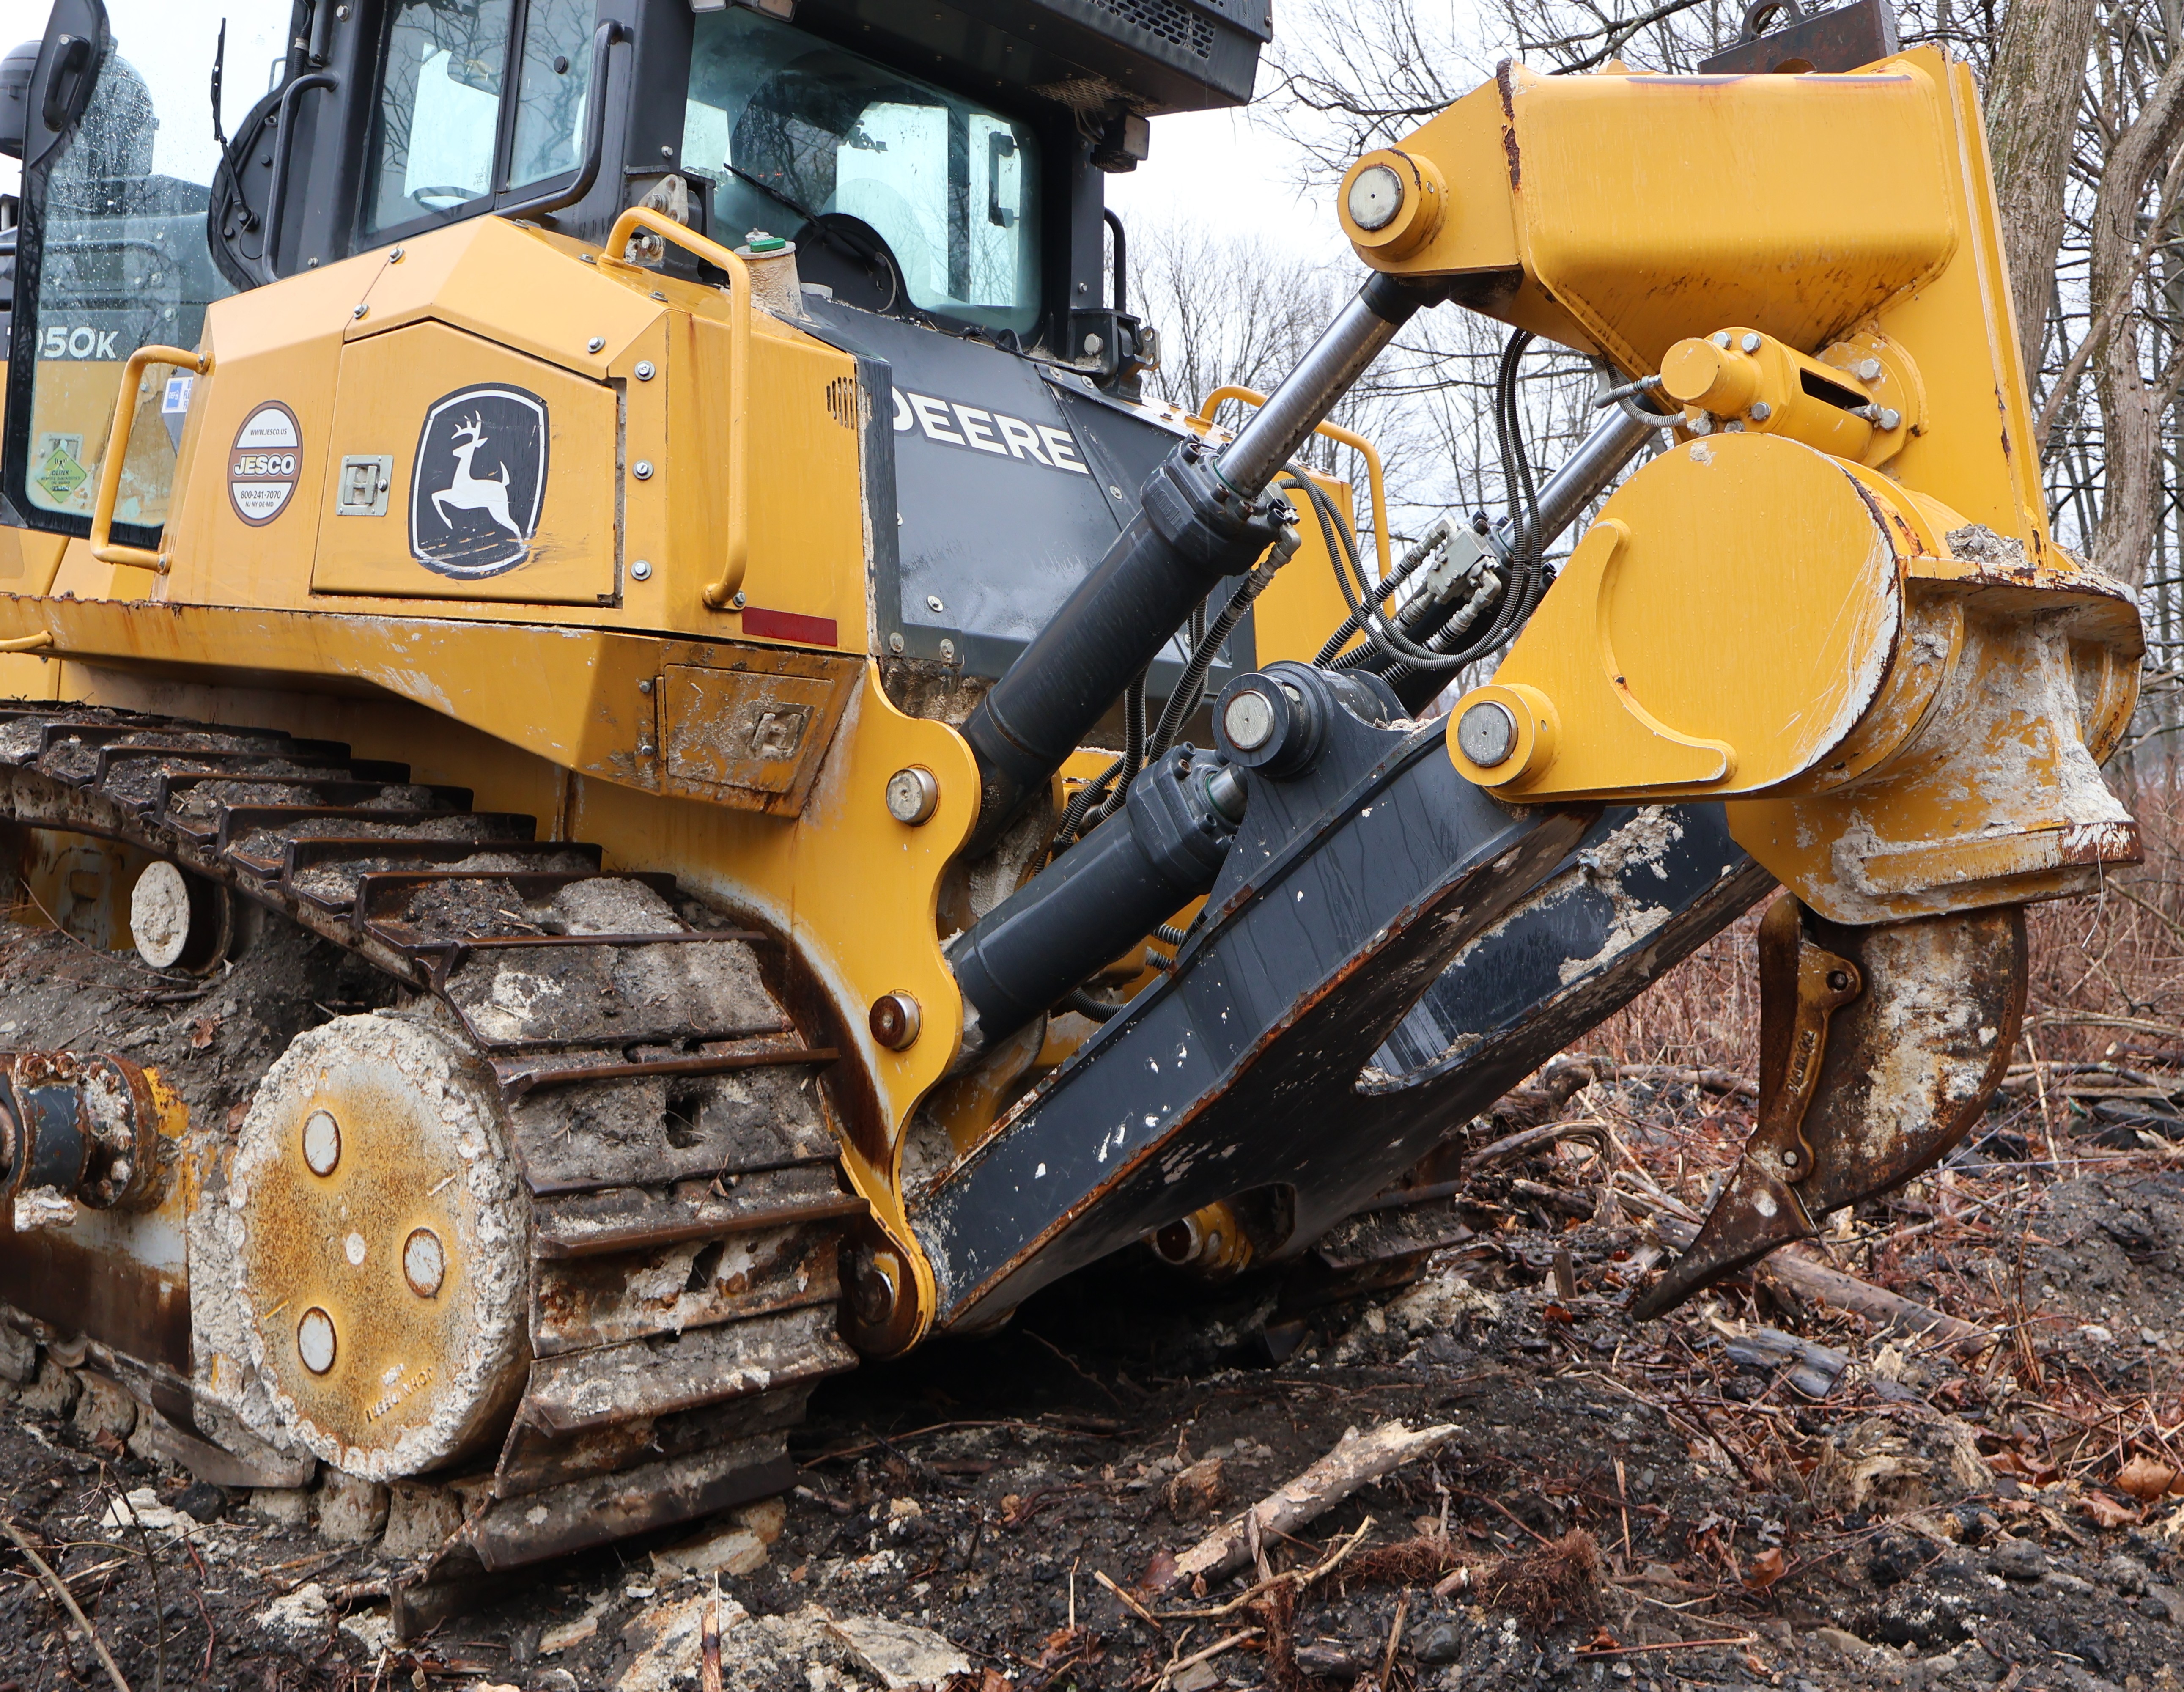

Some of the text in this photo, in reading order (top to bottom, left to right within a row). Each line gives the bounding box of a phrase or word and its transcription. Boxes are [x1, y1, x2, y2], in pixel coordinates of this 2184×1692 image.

[7, 327, 119, 359] 50K
[234, 453, 296, 476] JESCO
[241, 491, 281, 499] 800-241-7070
